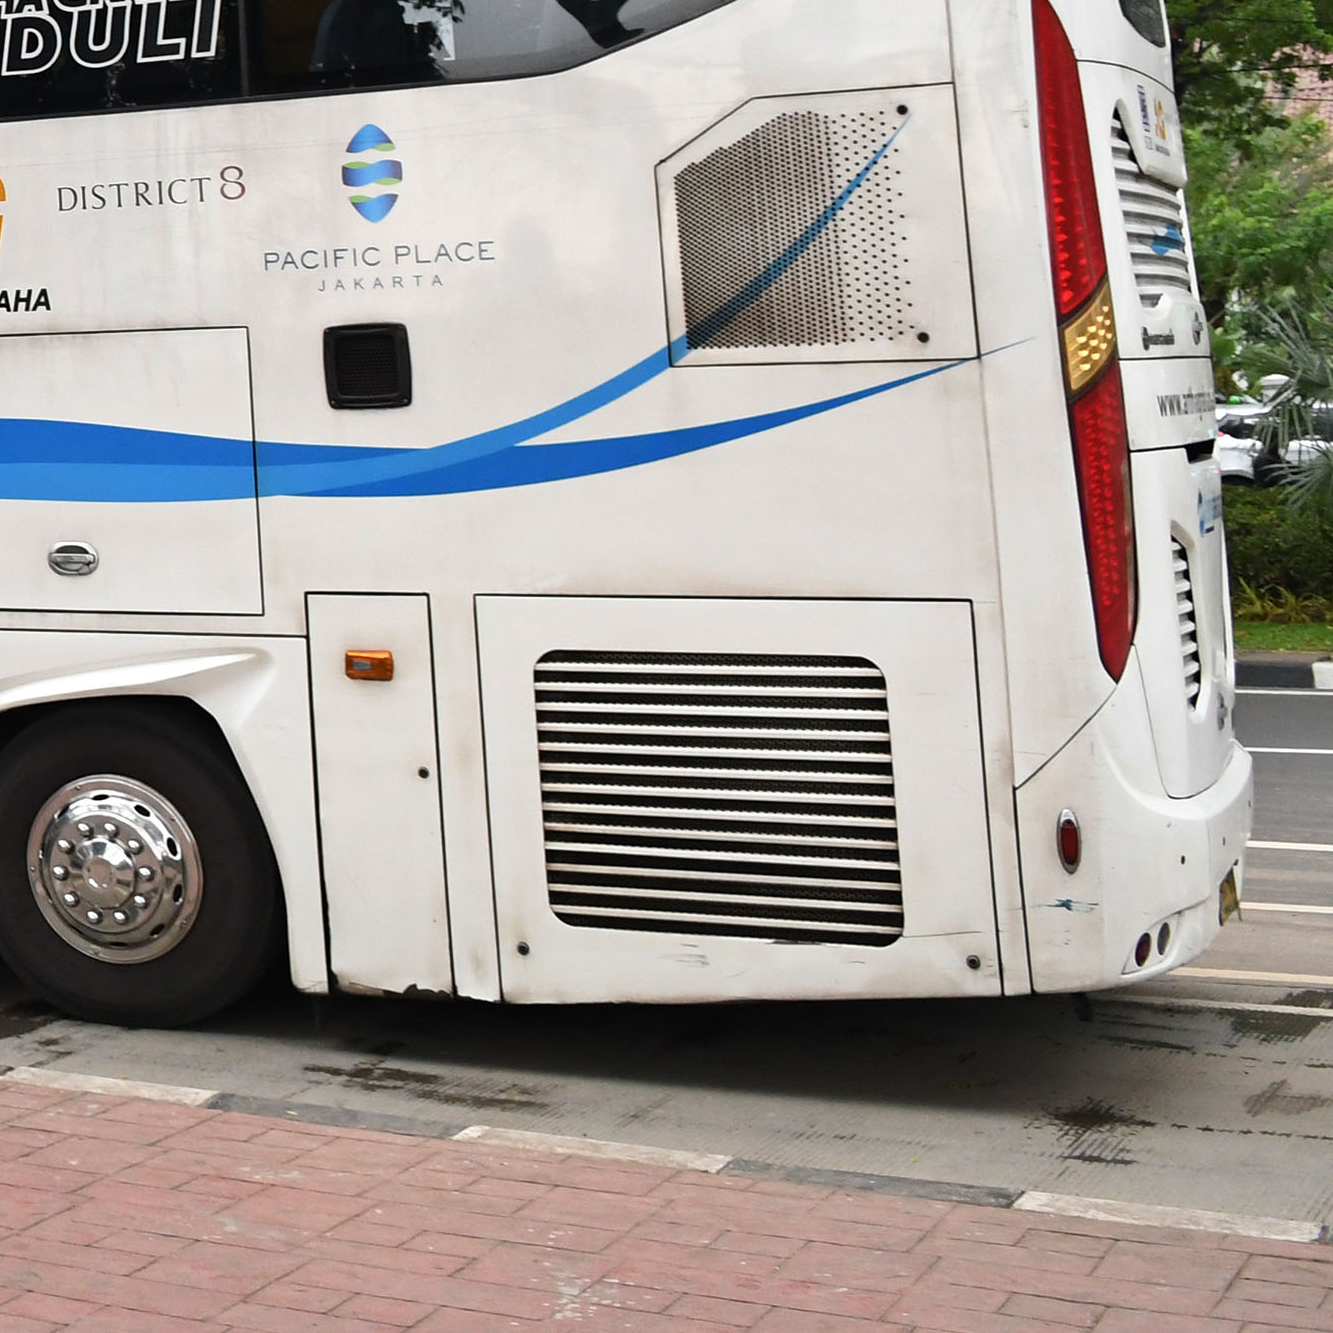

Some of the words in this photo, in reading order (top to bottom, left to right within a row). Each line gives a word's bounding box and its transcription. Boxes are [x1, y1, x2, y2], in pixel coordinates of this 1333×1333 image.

[56, 176, 212, 213] DISTRICT
[263, 245, 381, 272] PACIFIC
[393, 240, 496, 266] PLACE
[318, 274, 444, 293] JAKARTA
